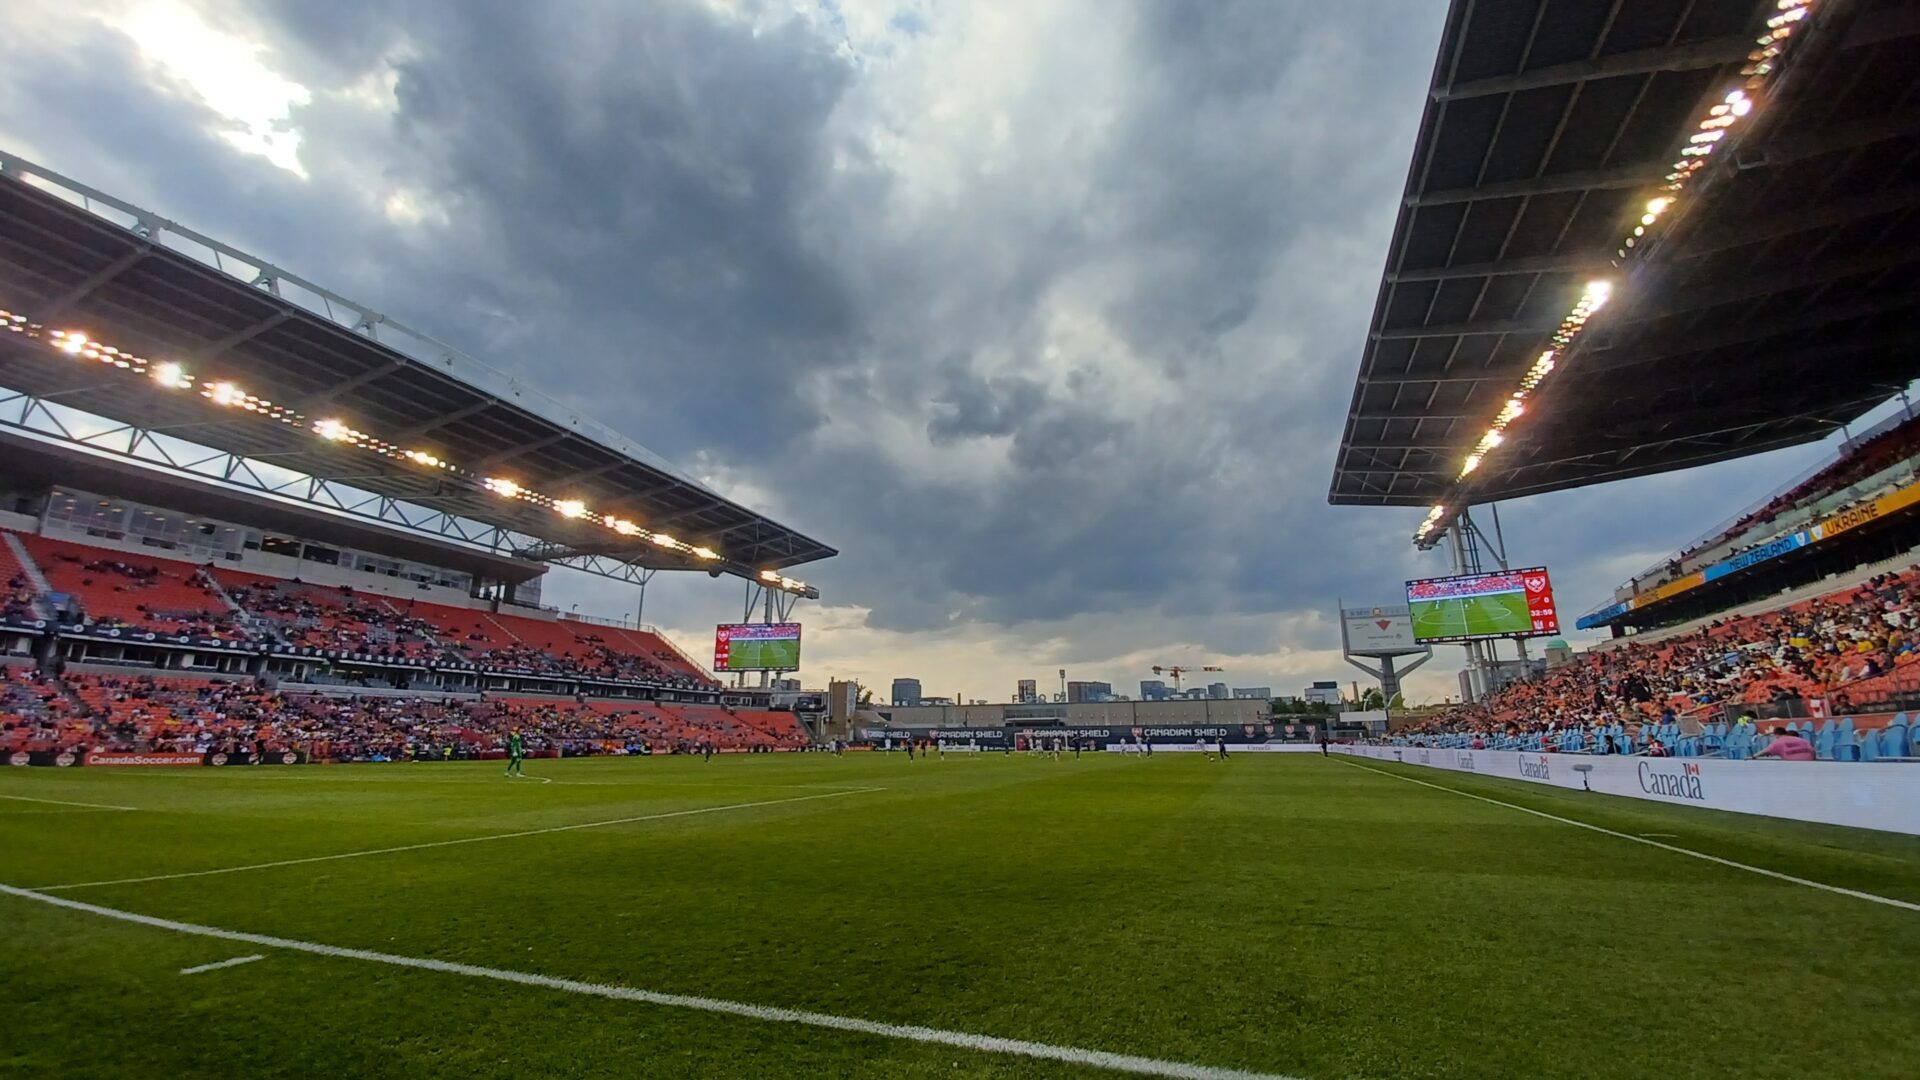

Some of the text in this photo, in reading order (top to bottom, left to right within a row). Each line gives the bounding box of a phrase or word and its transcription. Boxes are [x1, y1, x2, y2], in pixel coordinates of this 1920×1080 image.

[1826, 503, 1878, 534] UKRAINE
[1729, 539, 1792, 571] NEW ZEALAND
[936, 730, 1003, 738] CANADIAN SHIELD
[1034, 729, 1110, 738] CANADIAN SHIELD
[1144, 728, 1227, 737] CANADIAN SHIELD
[89, 754, 200, 765] CanadaSoccer.com
[1519, 754, 1550, 780] Canada
[1638, 761, 1704, 800] Canada
